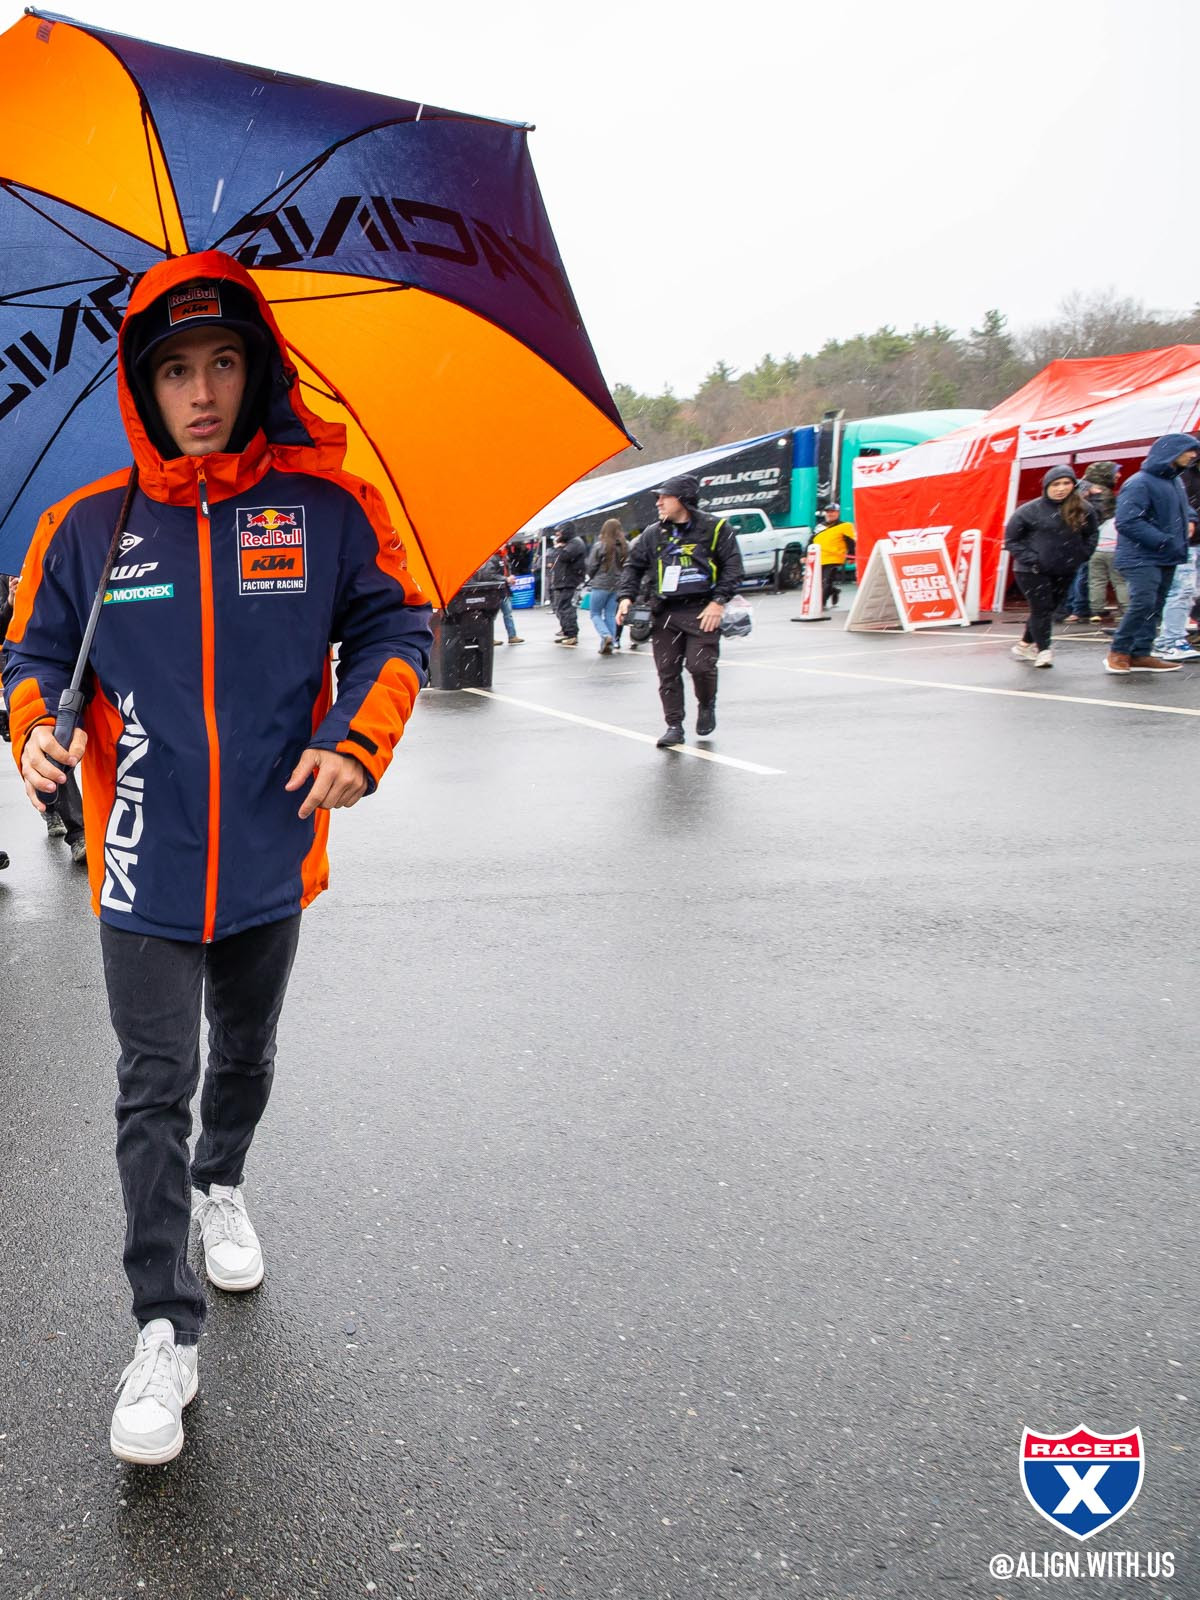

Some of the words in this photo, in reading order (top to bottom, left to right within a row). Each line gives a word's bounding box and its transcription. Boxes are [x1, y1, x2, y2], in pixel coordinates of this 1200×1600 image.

[170, 289, 193, 307] Red
[194, 287, 217, 299] Bull
[709, 490, 780, 506] DUNLOP
[241, 530, 272, 547] Red
[273, 529, 302, 545] Bull
[251, 554, 295, 572] KTM
[113, 585, 170, 601] MOTOREX
[243, 580, 275, 590] FACTORY
[277, 579, 304, 589] RACING
